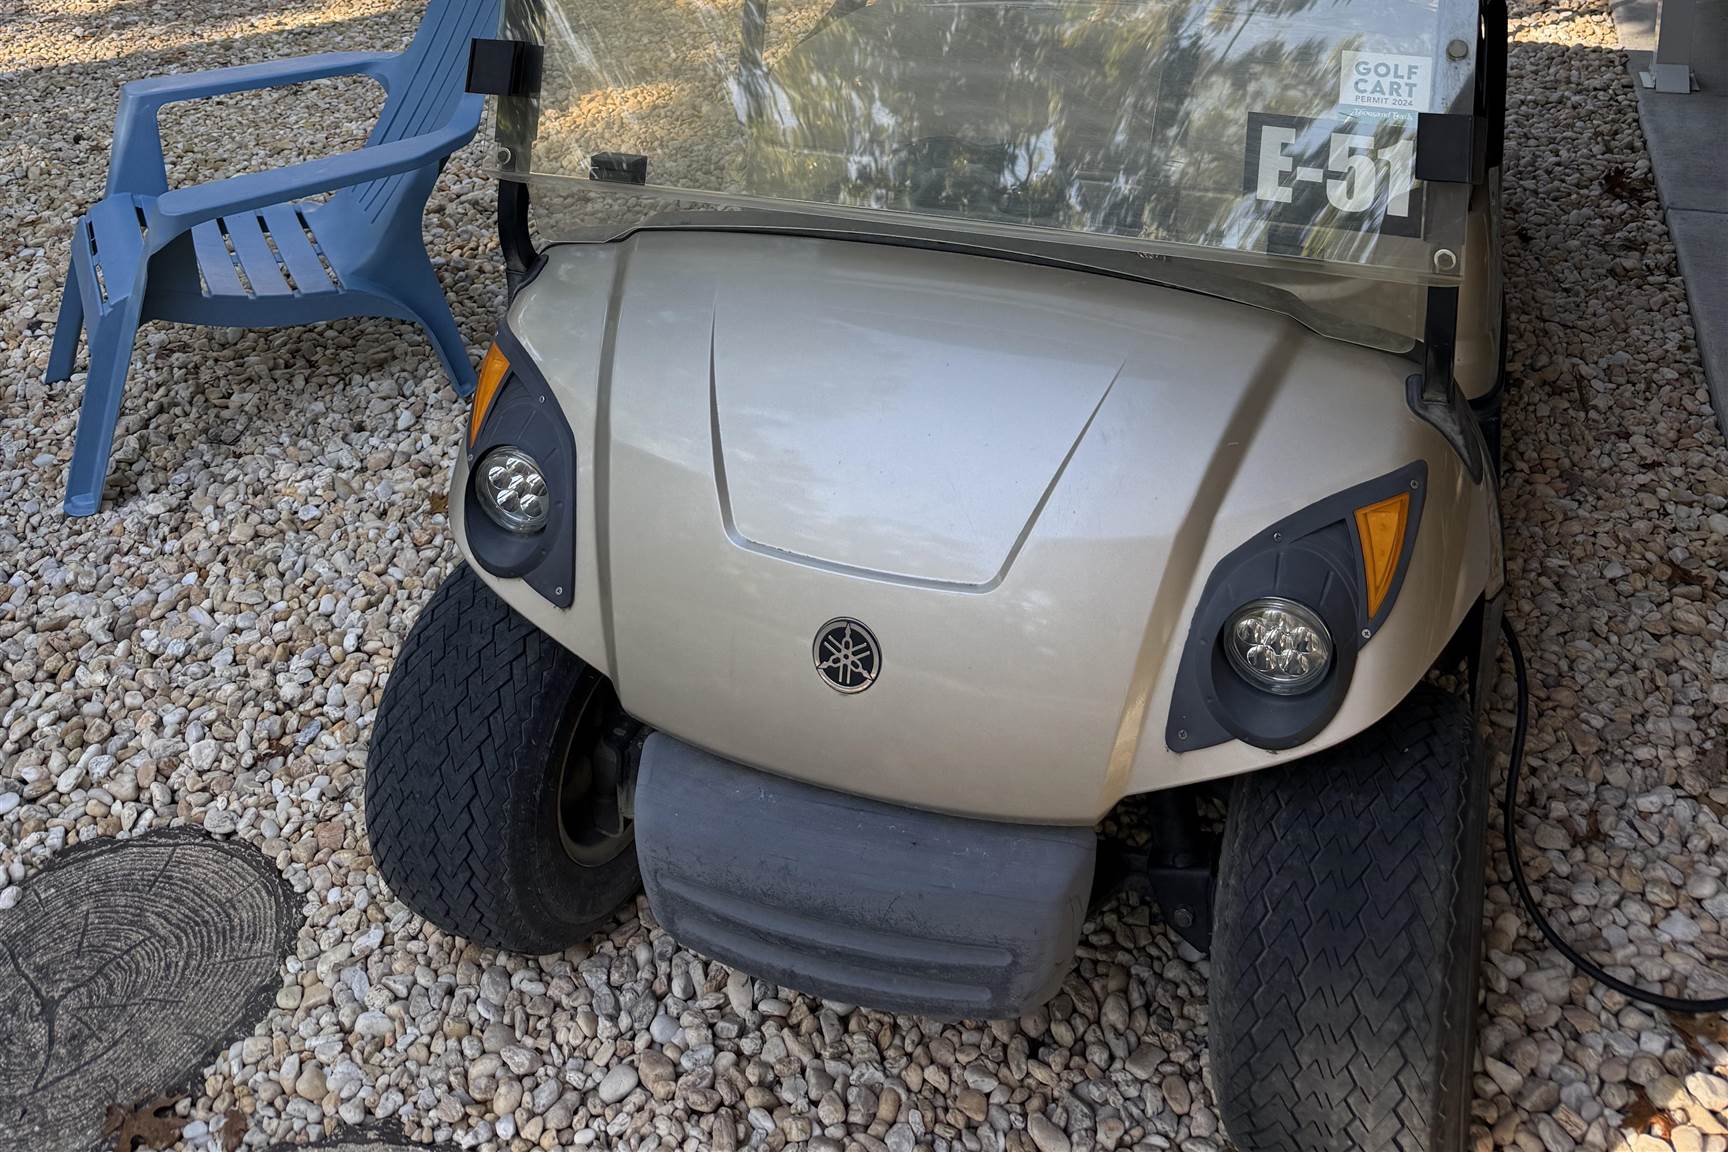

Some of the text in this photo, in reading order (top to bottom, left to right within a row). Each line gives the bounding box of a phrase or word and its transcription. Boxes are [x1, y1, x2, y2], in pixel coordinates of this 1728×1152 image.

[1355, 61, 1419, 80] GOLF
[1354, 78, 1417, 98] CART
[1355, 95, 1414, 107] PERMIT 2024
[1257, 125, 1414, 218] E-51
